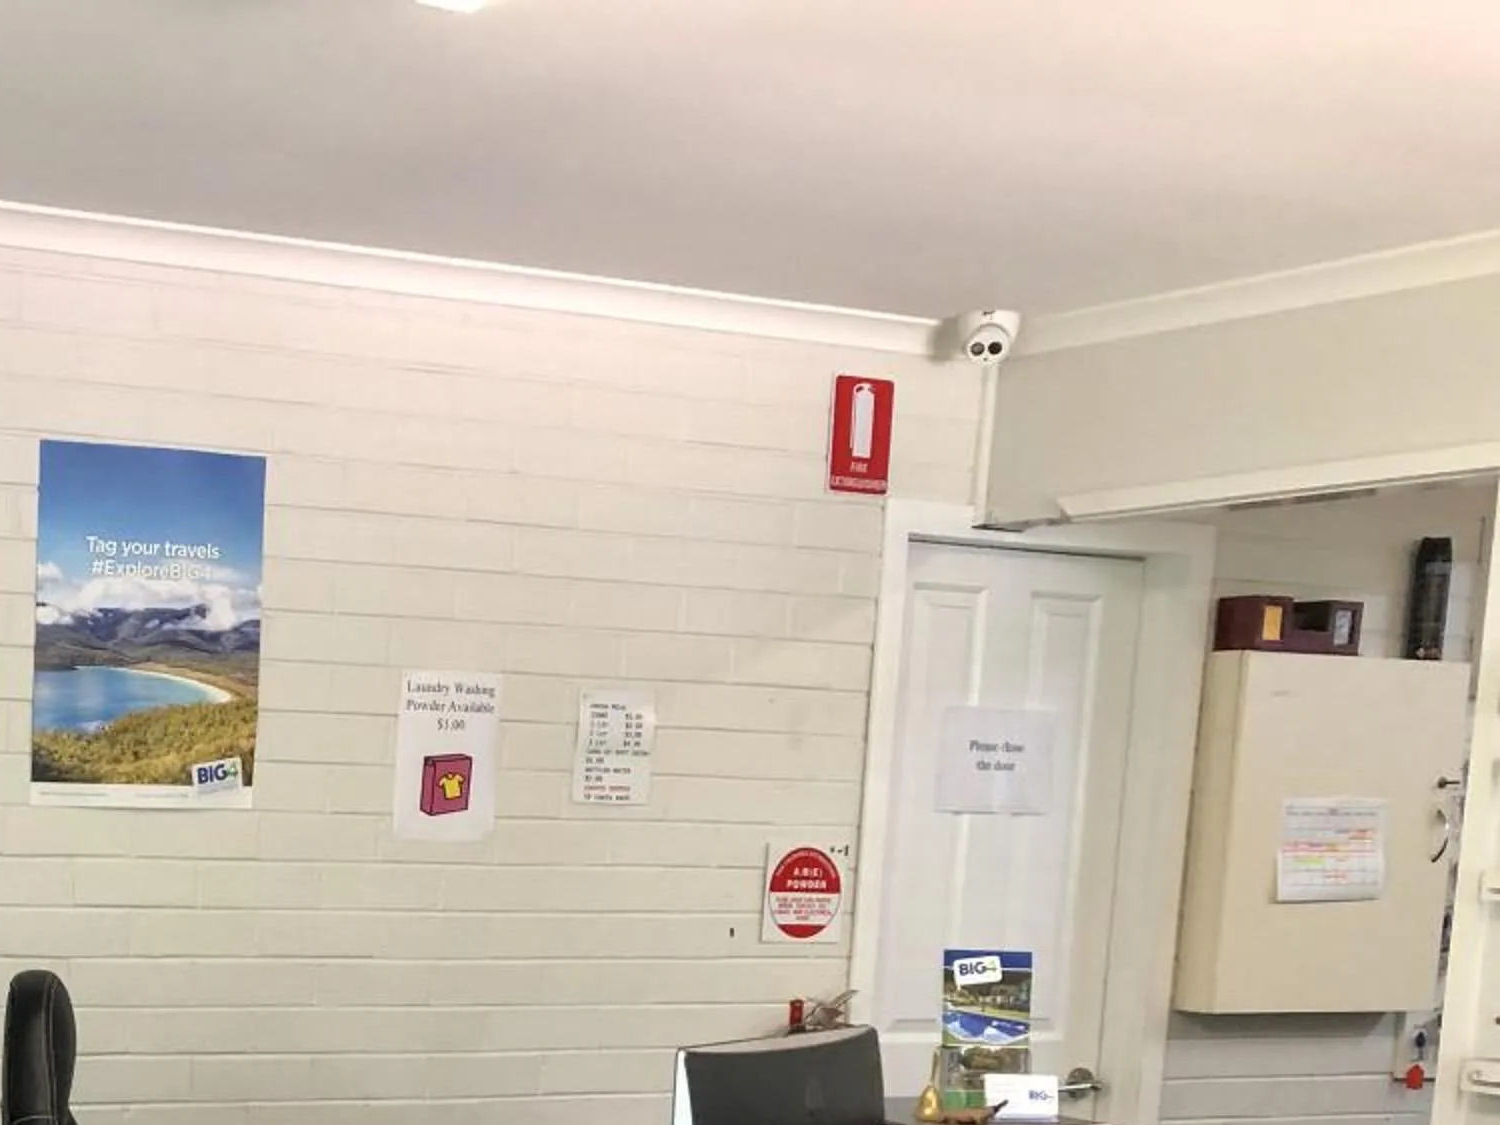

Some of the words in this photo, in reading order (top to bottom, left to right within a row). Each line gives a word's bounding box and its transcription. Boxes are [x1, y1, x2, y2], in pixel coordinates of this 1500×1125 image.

[85, 535, 117, 557] Tag
[121, 540, 161, 557] your
[164, 540, 221, 559] travels
[90, 559, 212, 580] #ExploreBIG4
[407, 680, 449, 697] Laundry
[454, 681, 496, 699] Washing
[406, 699, 446, 712] Powder
[448, 700, 495, 713] Available
[968, 739, 998, 752] Please
[197, 763, 238, 784] BIG4
[976, 760, 991, 771] the
[786, 879, 827, 889] POWDER
[958, 960, 997, 976] BIG4
